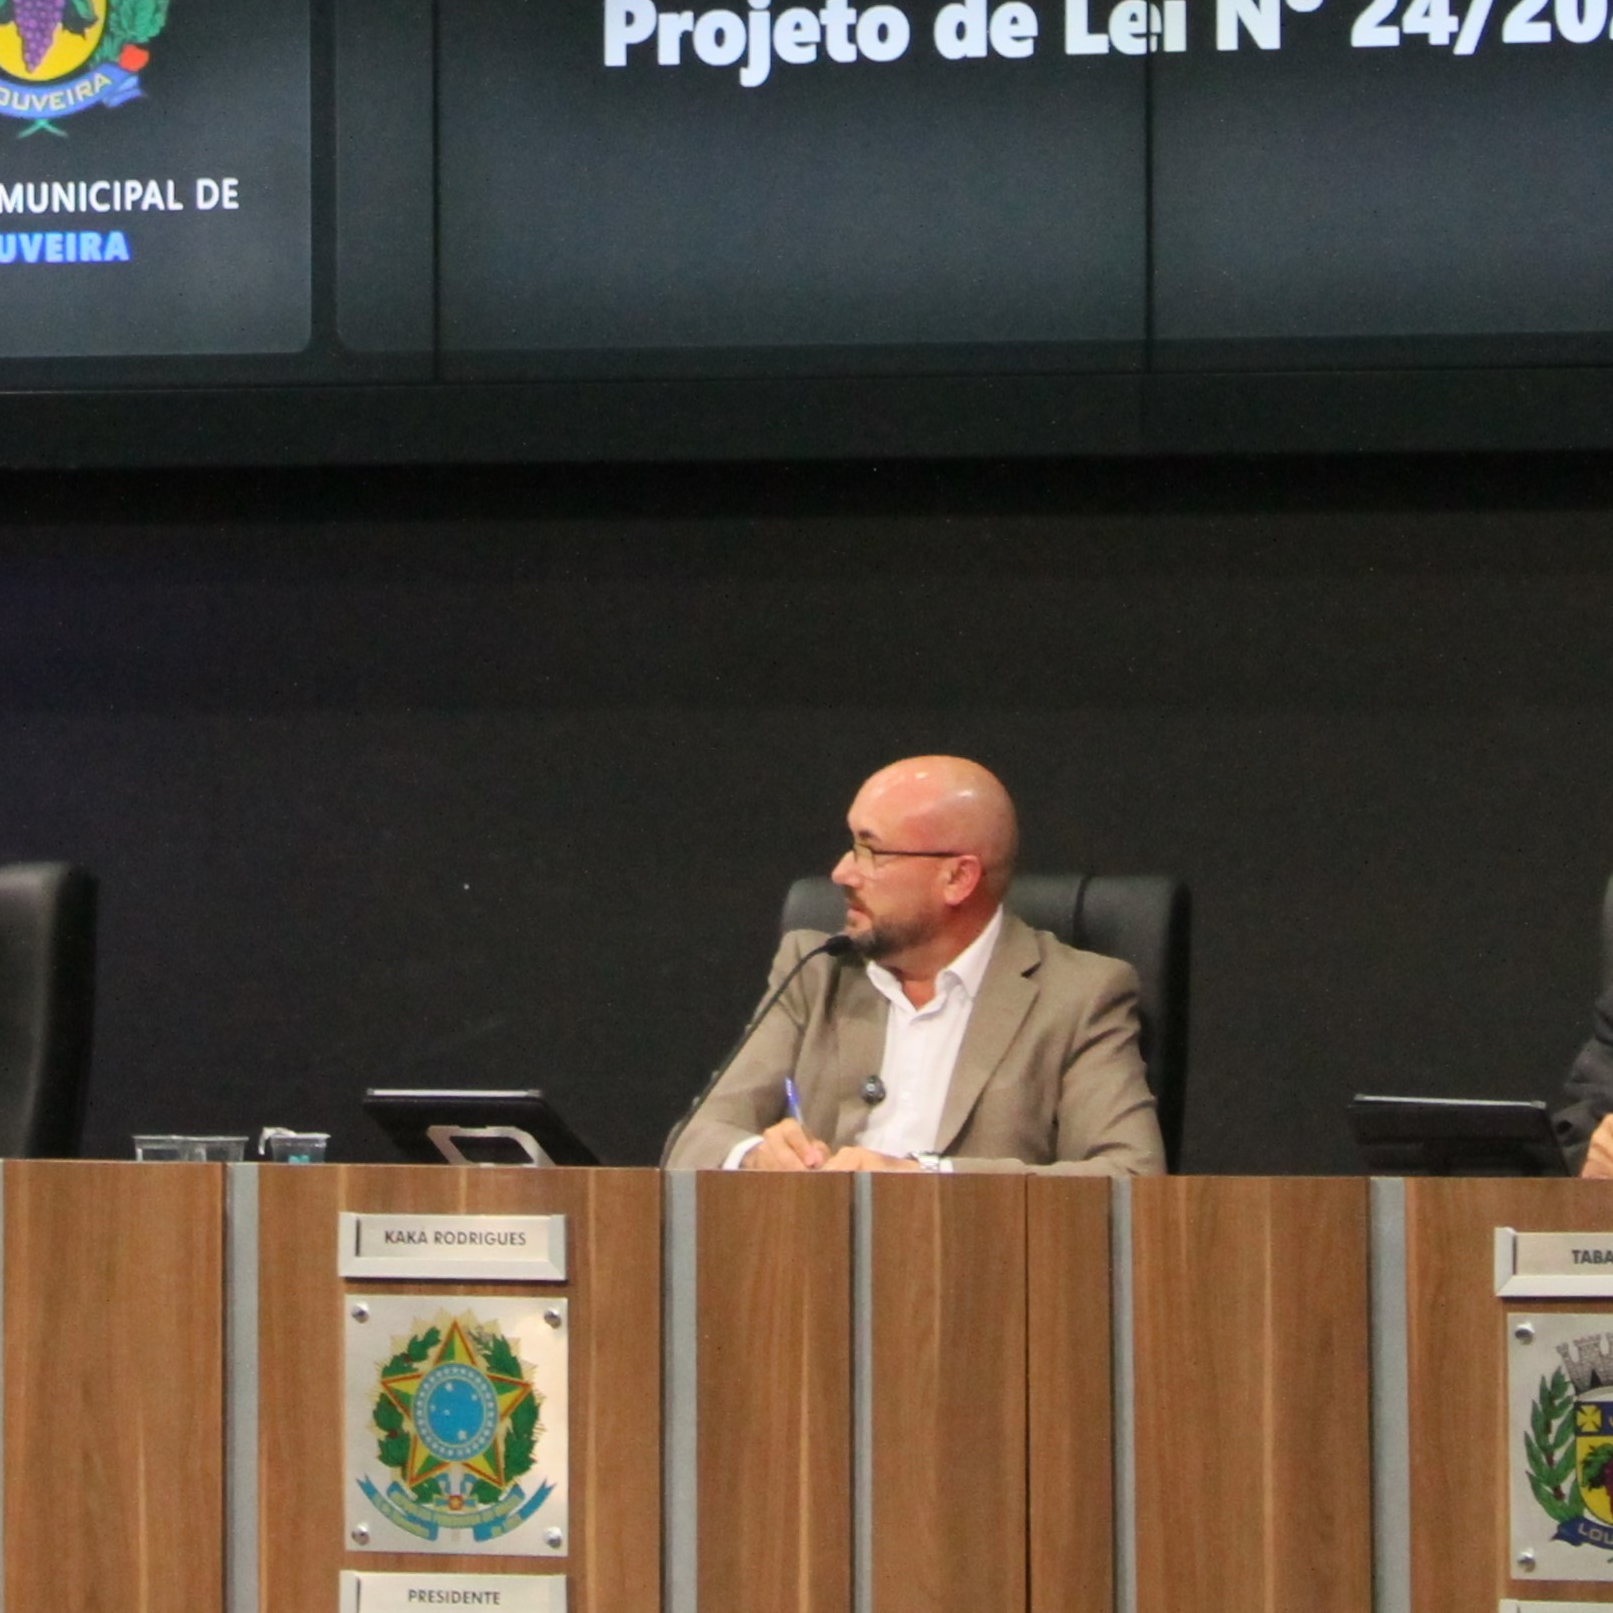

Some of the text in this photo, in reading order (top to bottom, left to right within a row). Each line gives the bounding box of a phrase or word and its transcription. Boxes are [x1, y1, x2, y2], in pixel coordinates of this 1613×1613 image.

[196, 178, 239, 209] DE
[434, 1231, 526, 1246] RODRIGUES
[408, 1589, 501, 1605] PRESIDENTE
